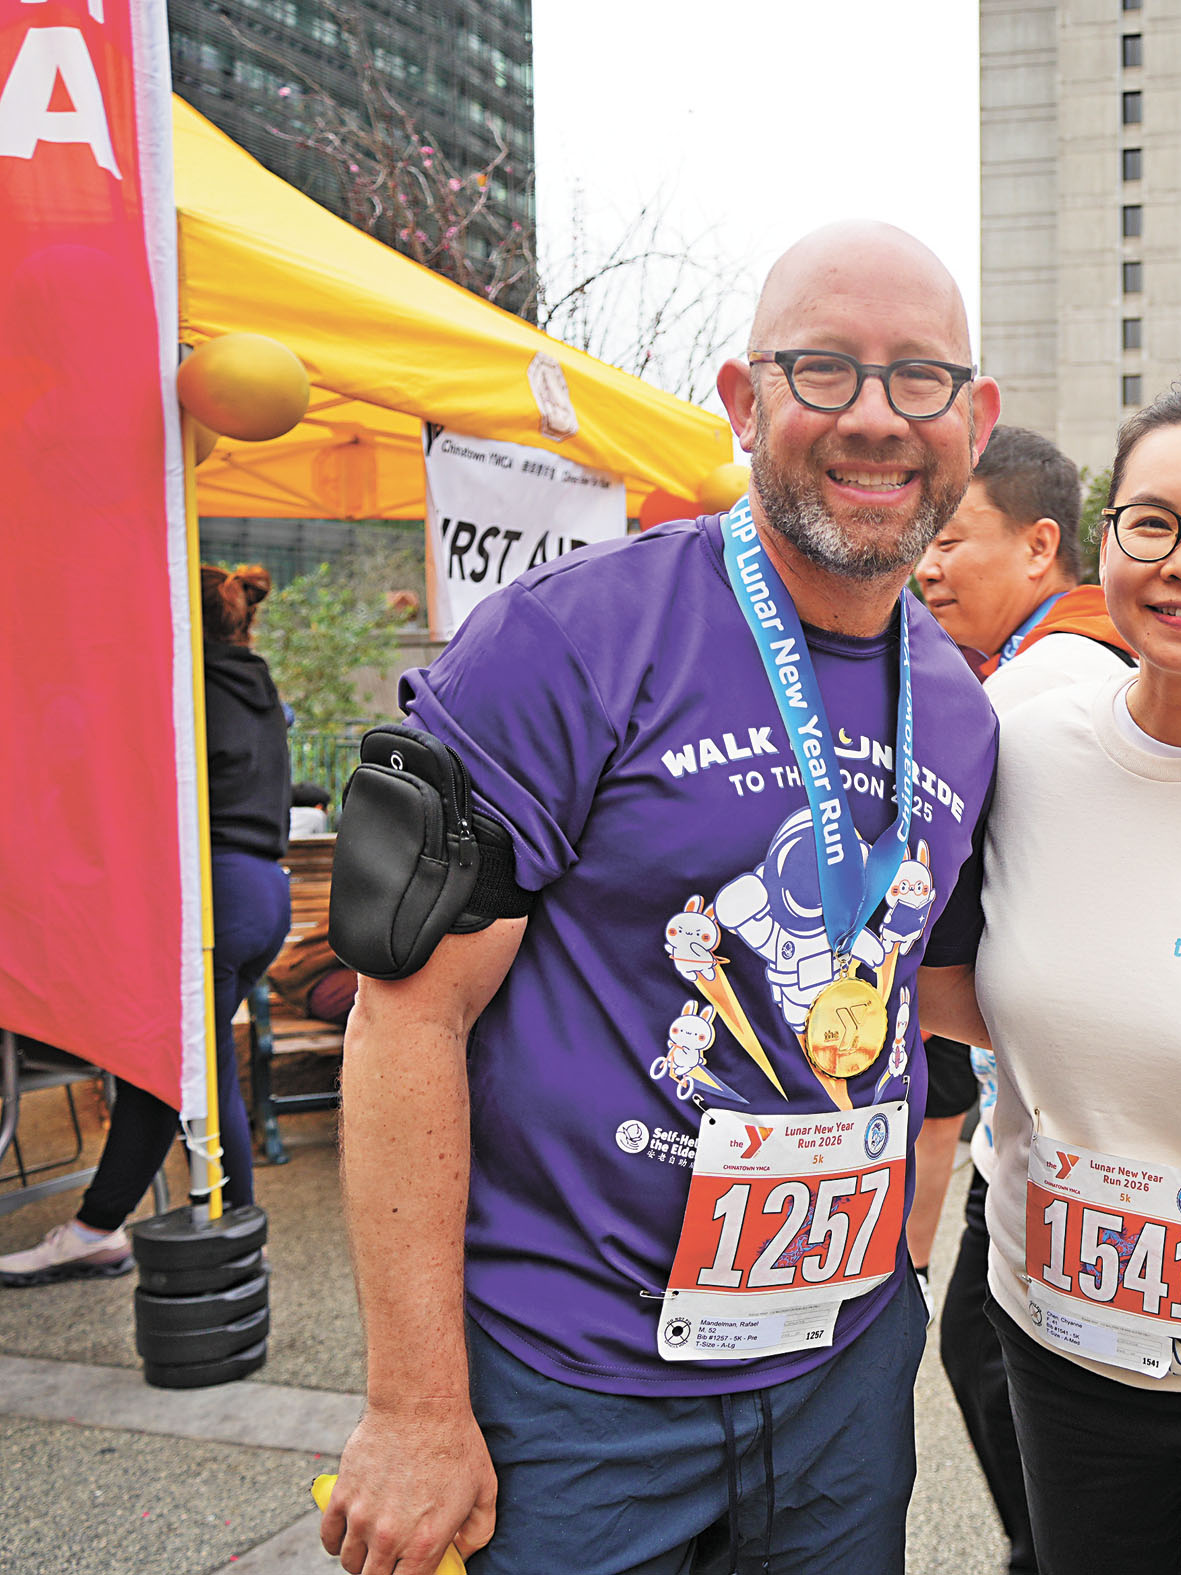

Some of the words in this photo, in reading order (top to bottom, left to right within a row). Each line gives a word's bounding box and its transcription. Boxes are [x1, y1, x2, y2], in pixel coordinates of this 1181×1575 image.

[0, 27, 123, 181] A
[441, 439, 486, 463] Chinatown
[736, 545, 785, 632] Lunar
[769, 637, 809, 709] New
[797, 714, 832, 791] Year
[818, 798, 845, 866] Run
[661, 726, 779, 778] WALK
[729, 771, 765, 797] TO
[771, 765, 806, 788] TH
[842, 770, 885, 799] OON
[784, 1124, 812, 1137] Lunar
[815, 1122, 835, 1134] New
[836, 1120, 854, 1132] Year
[649, 1138, 669, 1153] the
[652, 1127, 699, 1150] Self-Hel
[729, 1139, 743, 1149] the
[797, 1137, 816, 1149] Run
[818, 1136, 842, 1148] 2026
[812, 1154, 824, 1165] 5k
[1046, 1161, 1057, 1170] the
[723, 1164, 755, 1172] CHINATOWN
[1090, 1160, 1116, 1174] Lunar
[1118, 1167, 1139, 1179] New
[1141, 1171, 1164, 1184] Year
[1044, 1179, 1068, 1192] CHINATOWN
[1069, 1187, 1081, 1195] YMCA
[1103, 1175, 1122, 1187] Run
[1123, 1179, 1150, 1192] 2026
[1119, 1192, 1131, 1203] 5k
[696, 1167, 891, 1288] 1257
[700, 1320, 738, 1328] Mandelman,
[806, 1330, 824, 1340] 1257
[1142, 1357, 1160, 1368] 1541
